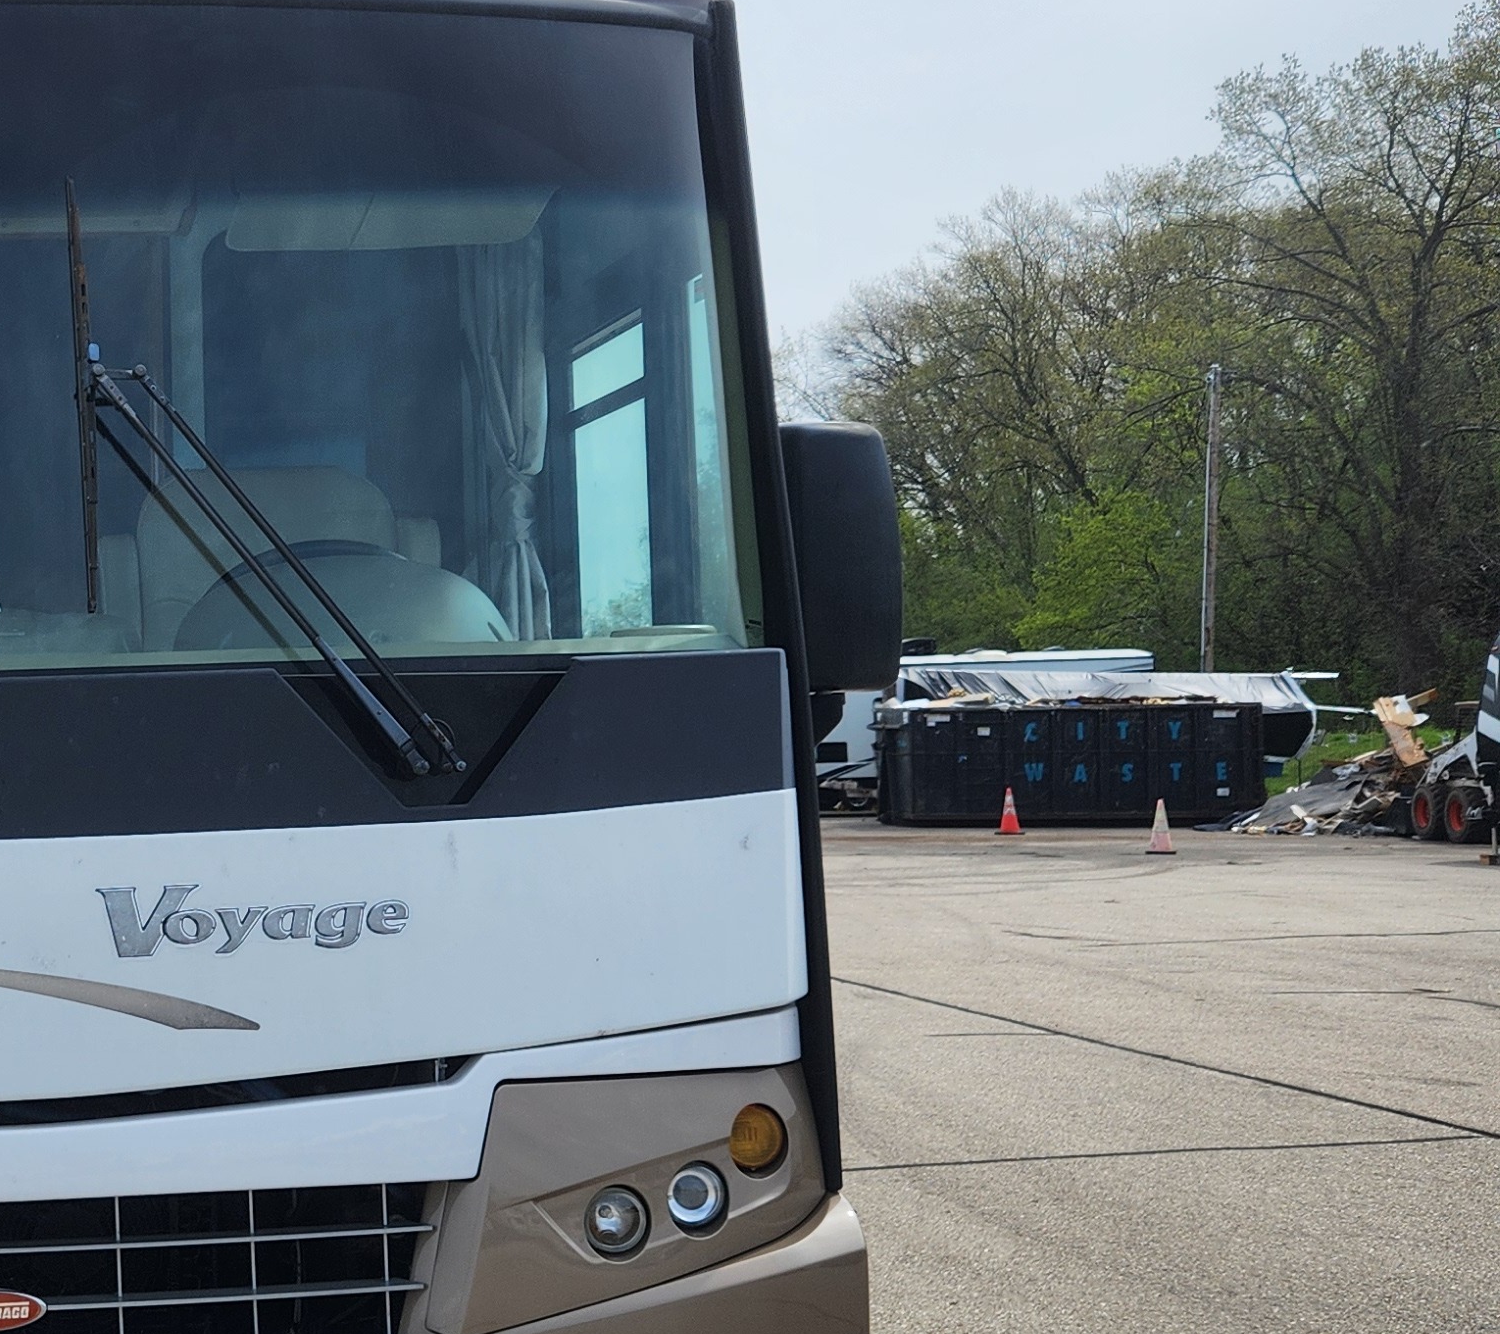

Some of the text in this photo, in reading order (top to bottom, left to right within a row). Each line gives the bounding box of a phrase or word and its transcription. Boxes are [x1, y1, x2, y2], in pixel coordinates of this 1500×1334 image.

[1024, 720, 1182, 742] CITY
[1024, 762, 1227, 783] WASTE
[95, 884, 410, 958] Voyage
